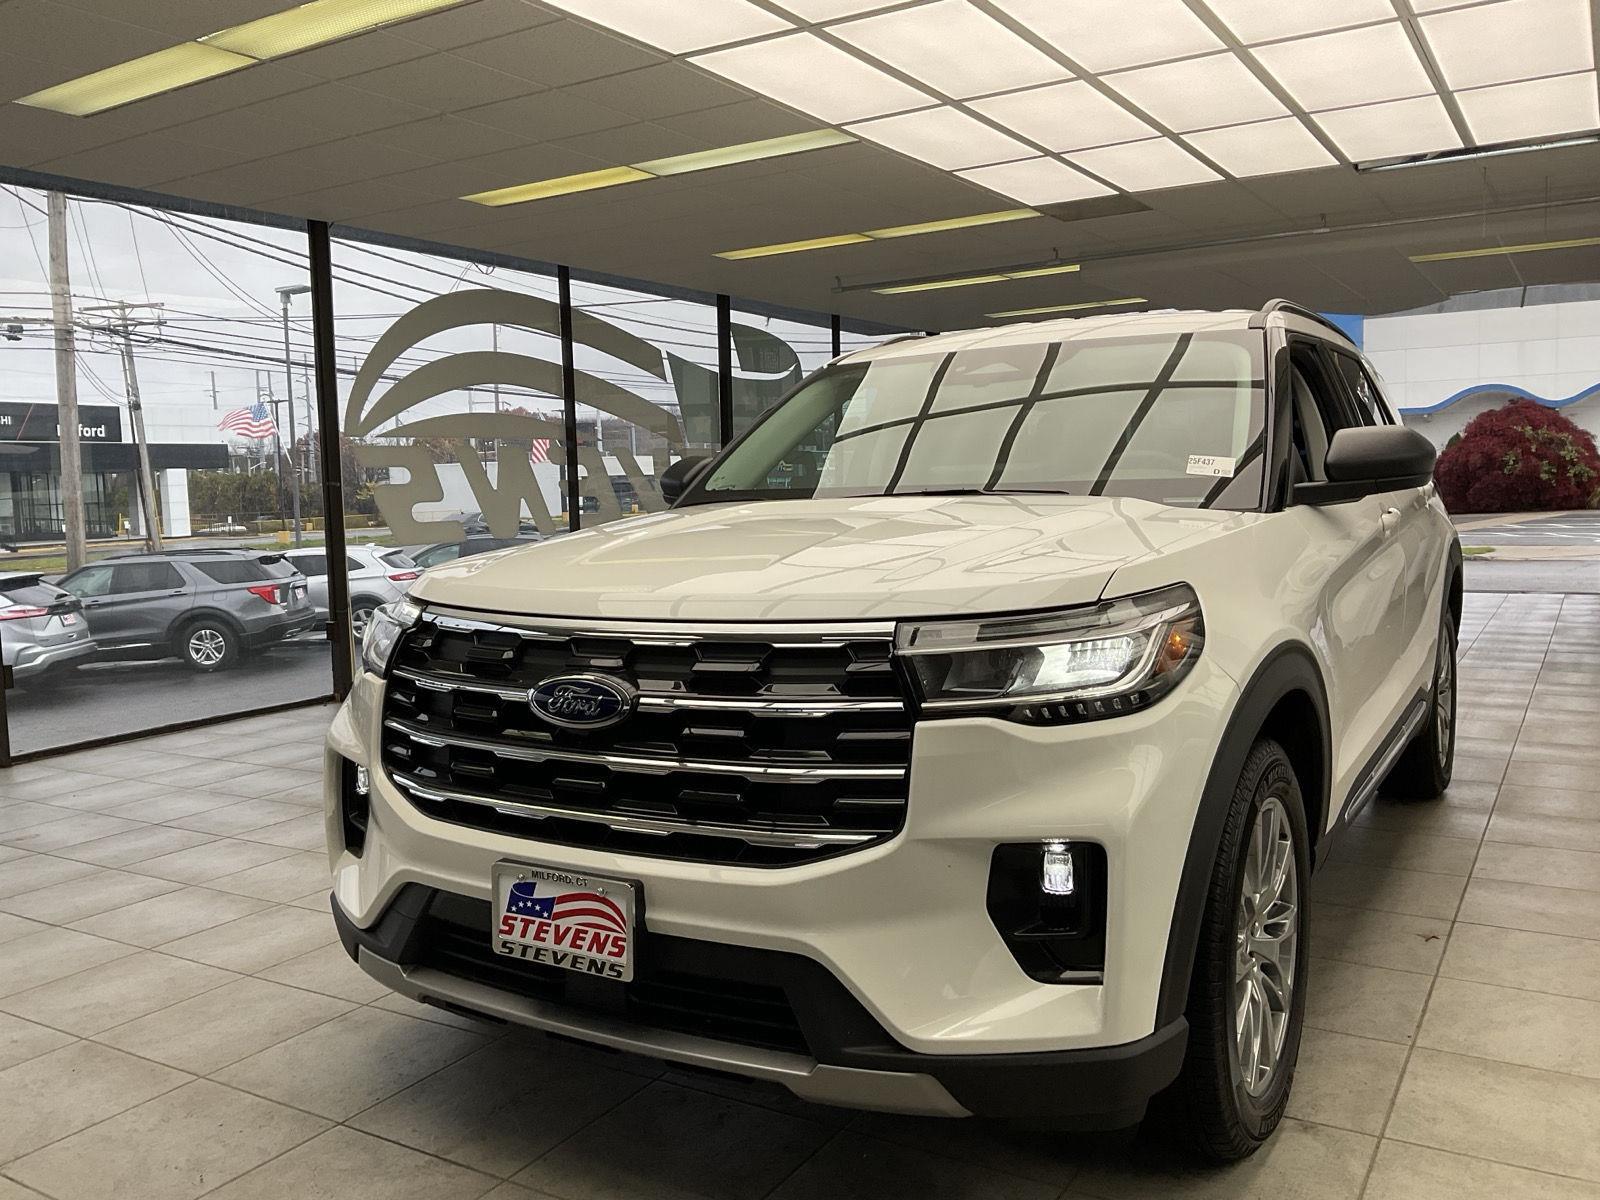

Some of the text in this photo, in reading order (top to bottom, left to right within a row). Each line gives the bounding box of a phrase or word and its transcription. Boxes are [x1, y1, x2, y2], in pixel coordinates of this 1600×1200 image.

[57, 423, 105, 437] ford
[548, 685, 603, 715] Ford
[576, 877, 588, 887] CT
[498, 914, 627, 958] STEVENS
[499, 940, 625, 979] STEVENS
